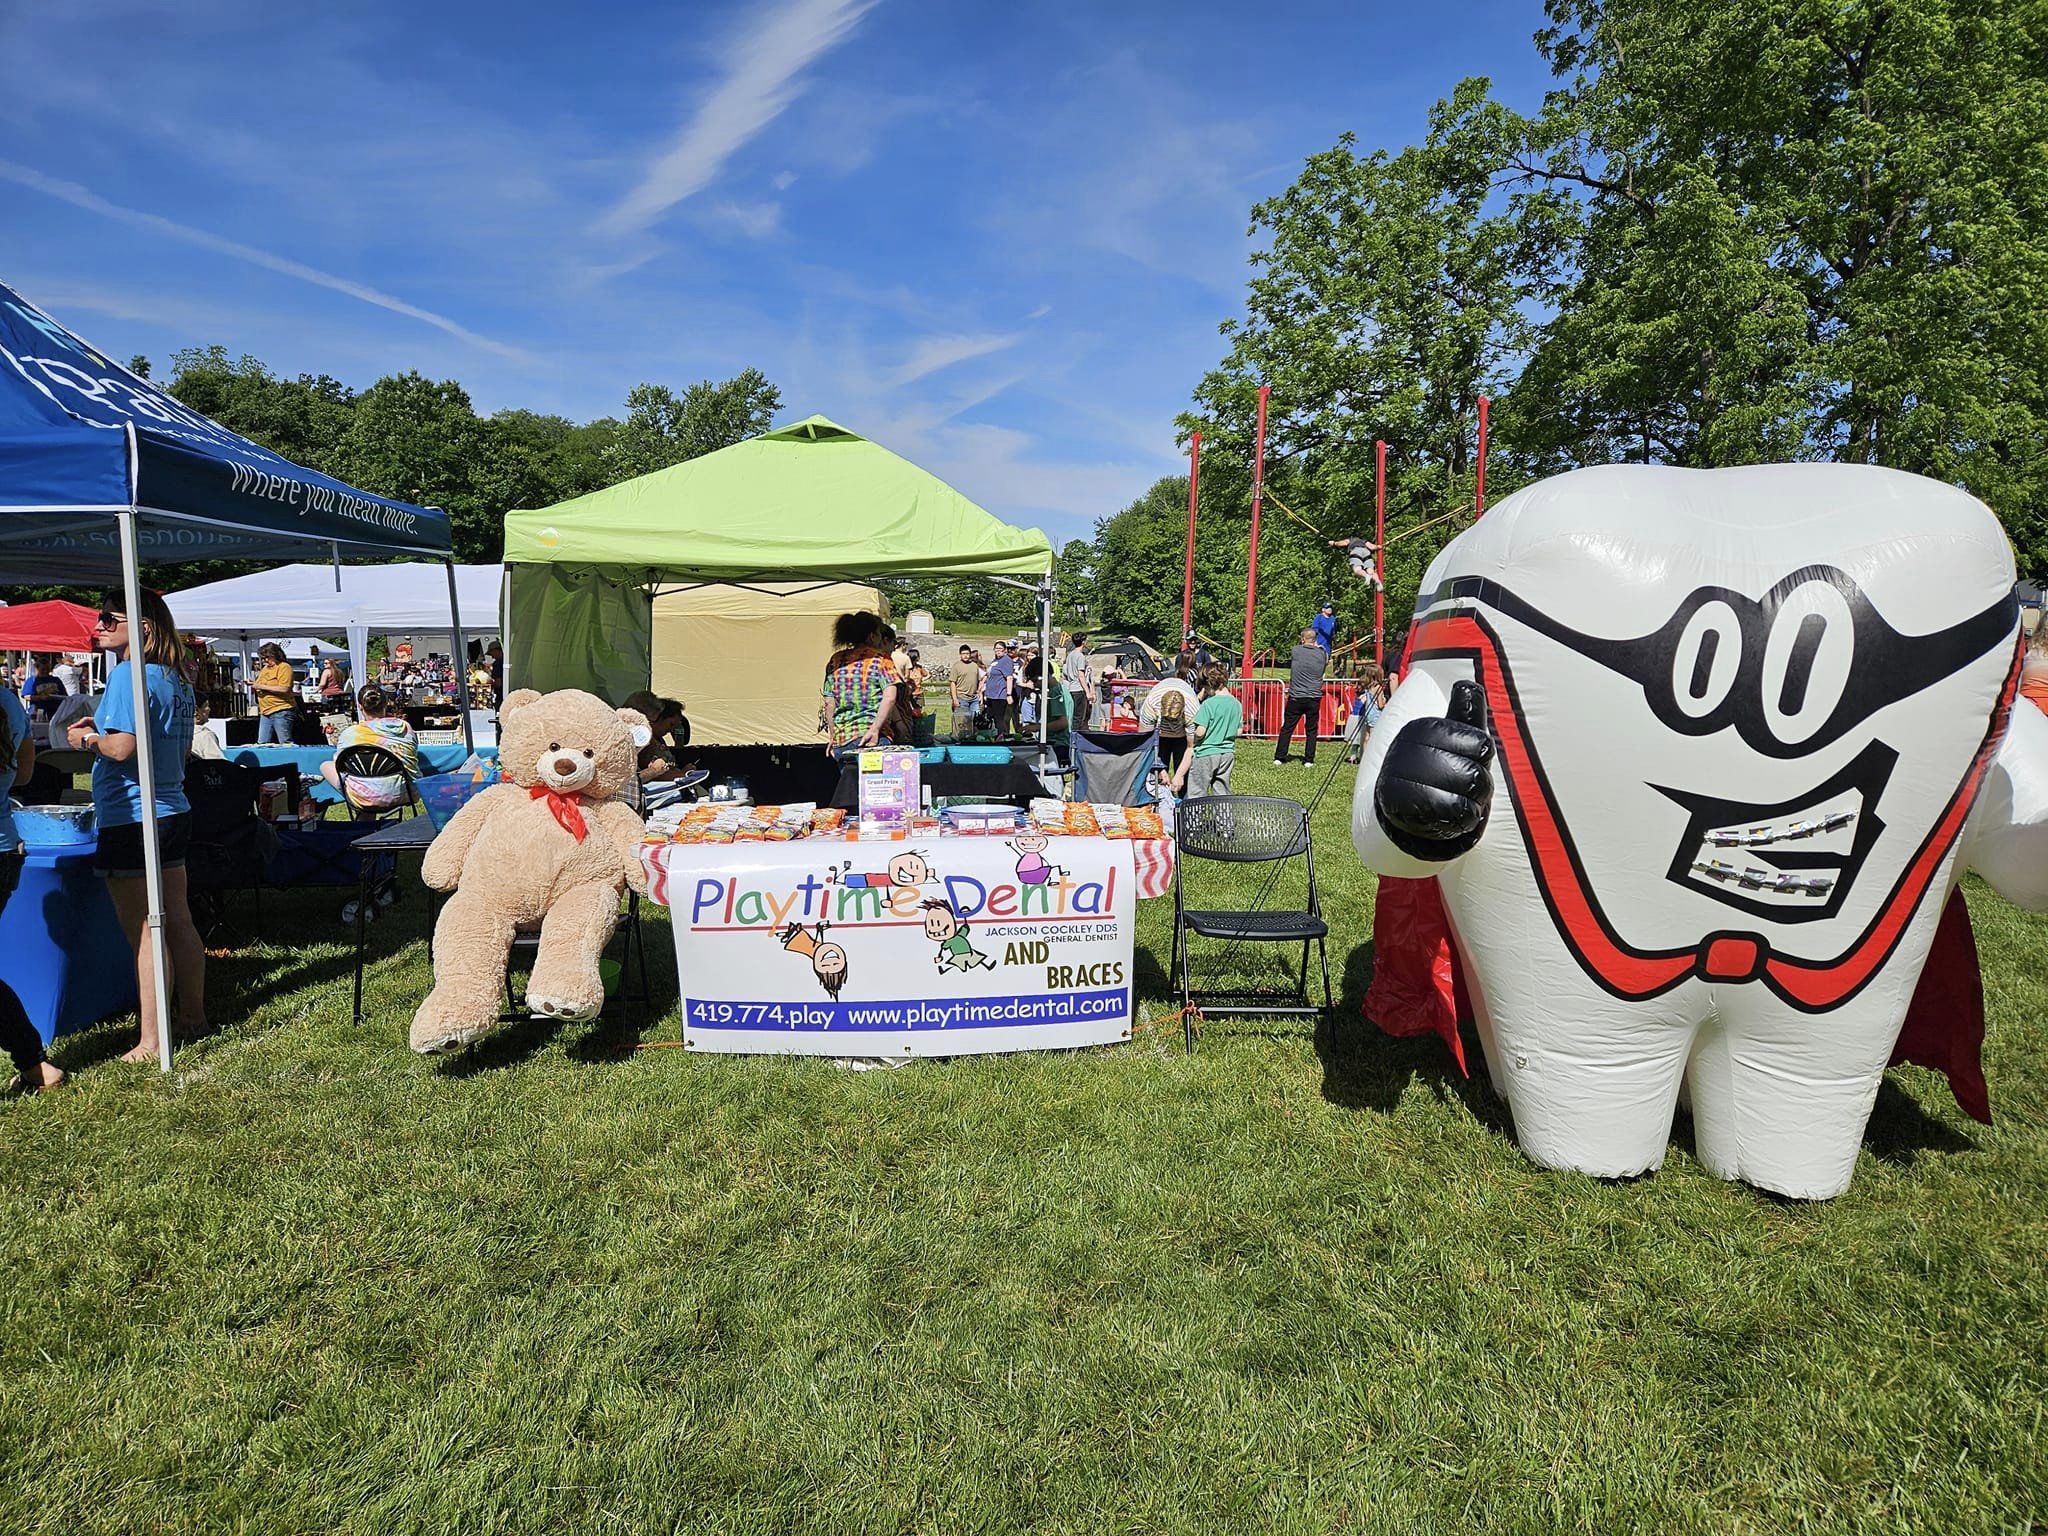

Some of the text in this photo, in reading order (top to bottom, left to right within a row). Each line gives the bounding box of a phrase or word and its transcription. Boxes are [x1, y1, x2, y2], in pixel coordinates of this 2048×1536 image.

[225, 459, 418, 536] Where you mean more.
[692, 866, 1116, 937] Playtime Dental
[985, 923, 1118, 936] JACKSON COCKLEY DDS
[1043, 933, 1118, 943] GENERAL DENTIST
[1004, 941, 1049, 965] AND
[1047, 962, 1123, 989] BRACES
[693, 996, 1123, 1030] 419.774.play www.playtimedental.com
